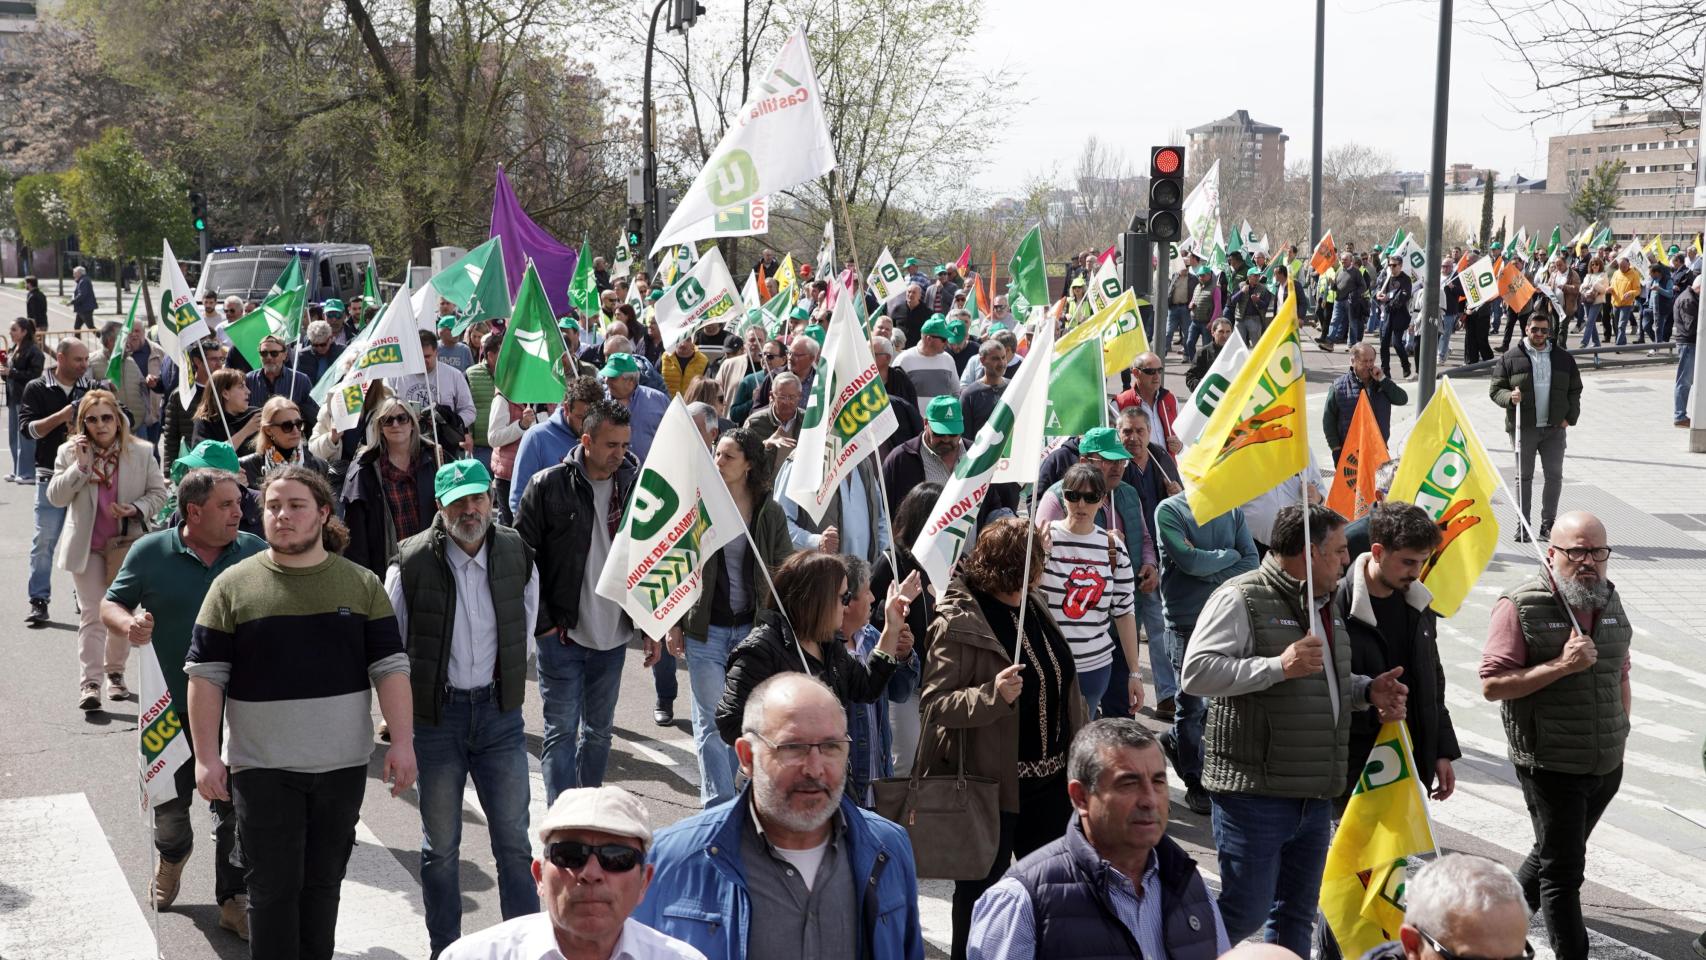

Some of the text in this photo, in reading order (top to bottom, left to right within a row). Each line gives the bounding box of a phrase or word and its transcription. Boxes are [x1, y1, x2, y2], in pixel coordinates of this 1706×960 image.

[828, 364, 880, 428] CAMPESINOS
[840, 384, 890, 435] UCCL
[837, 442, 859, 468] León
[928, 482, 987, 536] UNION DE
[626, 555, 655, 590] UNION
[652, 540, 670, 559] DE
[654, 576, 697, 621] Castilla y
